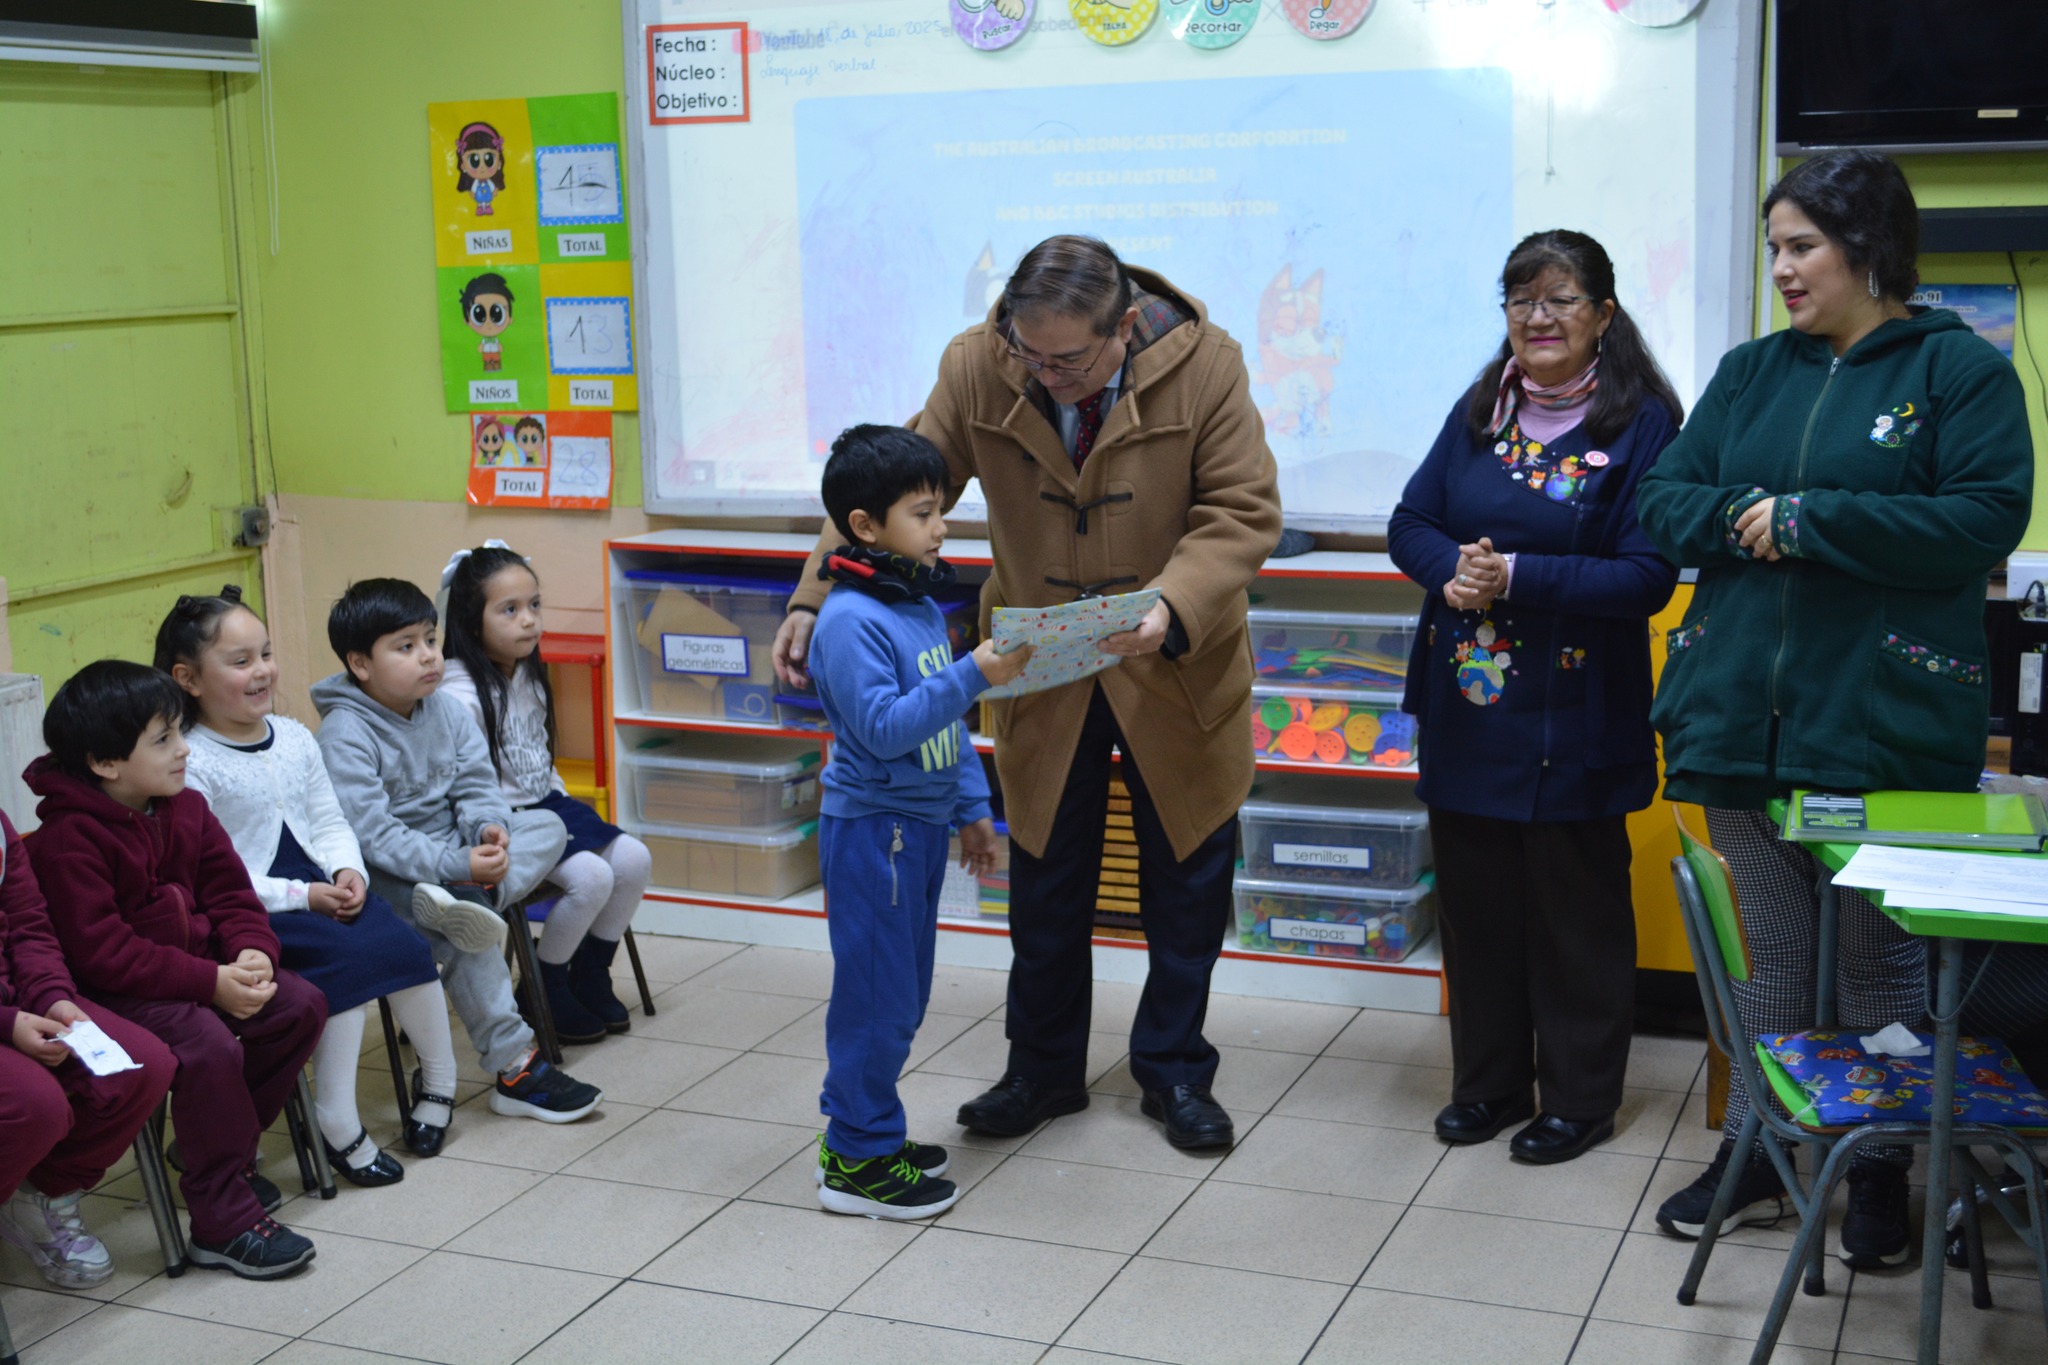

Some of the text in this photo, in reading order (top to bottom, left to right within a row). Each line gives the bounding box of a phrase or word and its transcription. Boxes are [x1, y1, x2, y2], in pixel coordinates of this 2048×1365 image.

[654, 36, 706, 54] Fecha
[655, 63, 716, 82] Núcleo
[656, 91, 728, 114] Objetivo
[968, 137, 1069, 156] AUSTRALIAN
[1074, 132, 1211, 153] BROADCASTING
[1215, 128, 1347, 149] CORPORATION
[1053, 166, 1217, 188] SCREEN AUSTRALIA
[1149, 199, 1280, 219] DISTRIBUTION
[568, 314, 613, 355] 13
[558, 442, 600, 486] 28
[682, 639, 726, 655] Figuras
[667, 656, 745, 672] geométricas
[1293, 849, 1349, 865] semillas
[1289, 924, 1345, 942] chapas
